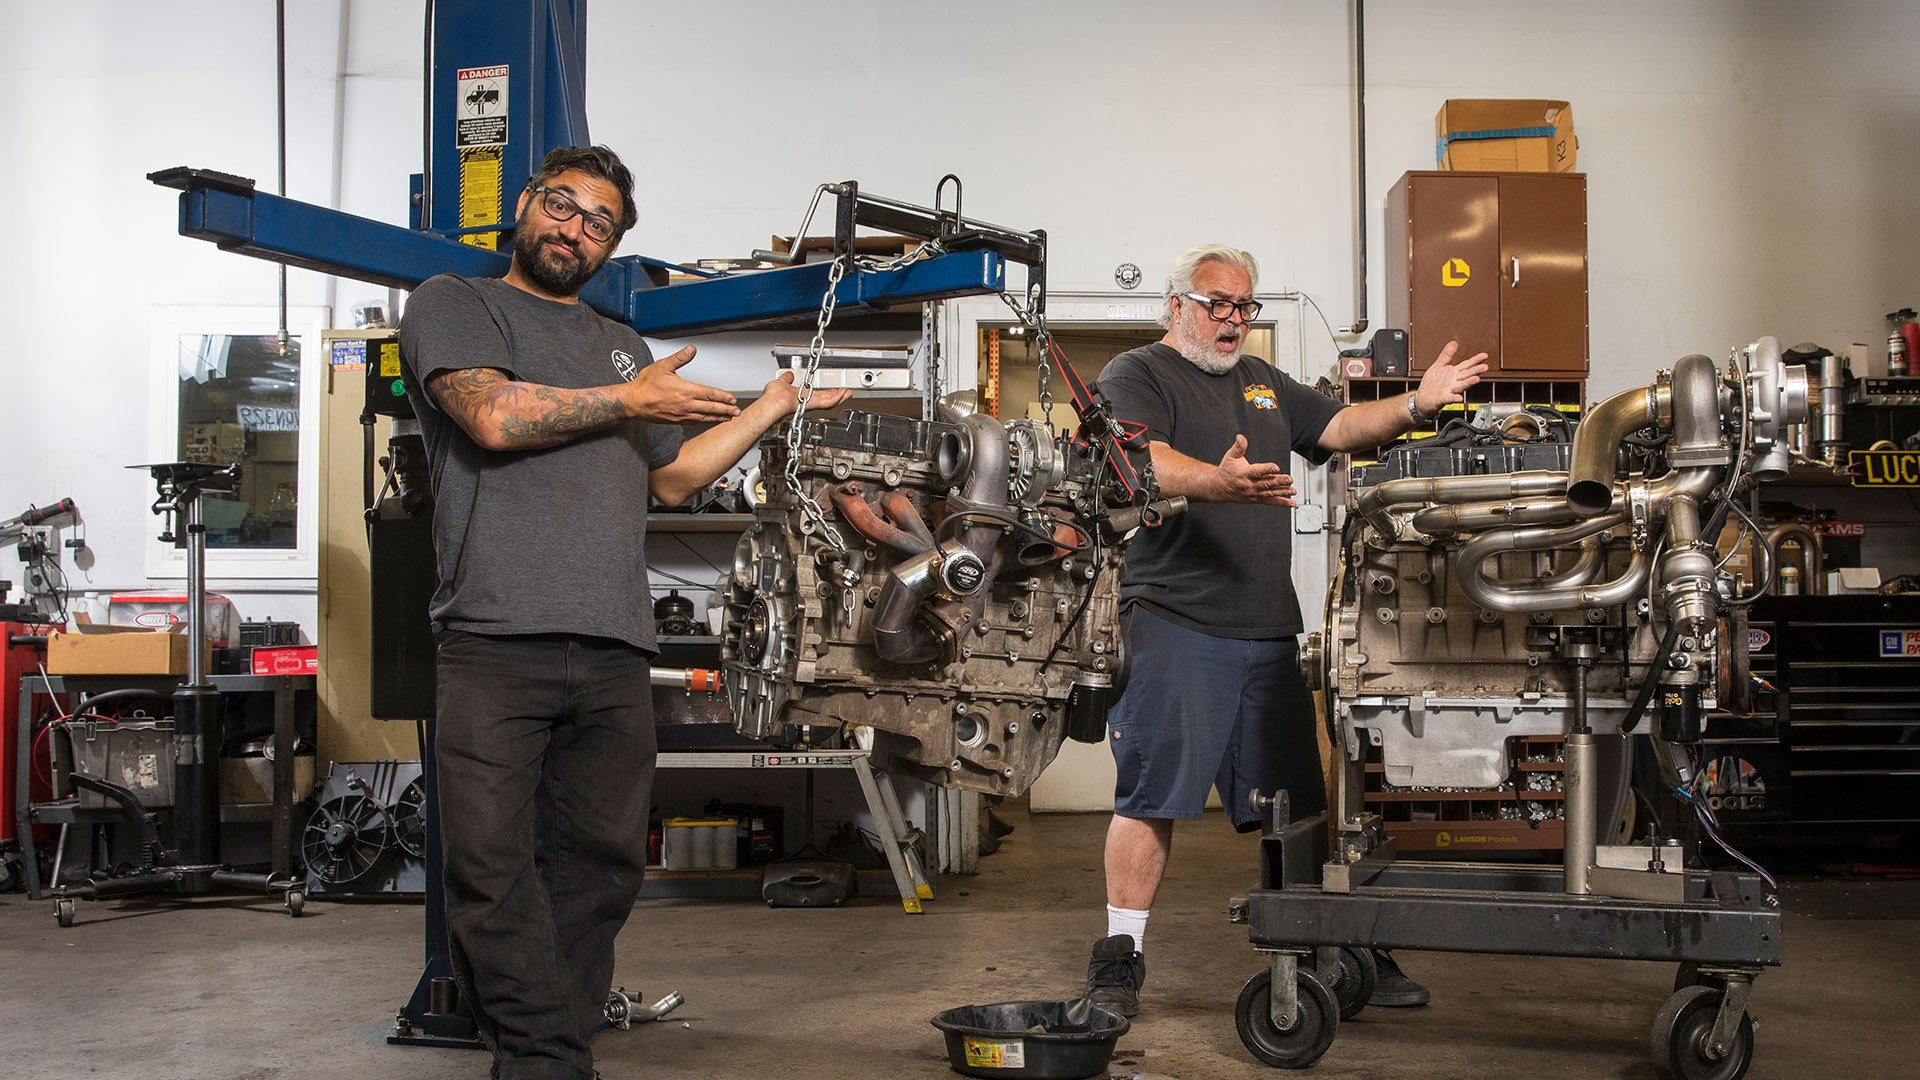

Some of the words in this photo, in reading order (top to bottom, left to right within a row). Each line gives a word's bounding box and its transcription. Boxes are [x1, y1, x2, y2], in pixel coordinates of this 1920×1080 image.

[469, 68, 506, 78] DANGER
[1557, 140, 1567, 162] K3
[1865, 454, 1920, 483] LUC
[1823, 524, 1865, 534] AMS
[1748, 632, 1765, 644] HRA
[1885, 636, 1898, 646] GM
[1708, 796, 1766, 810] OOLS
[1454, 835, 1487, 843] LAWSON
[1488, 835, 1518, 843] Products
